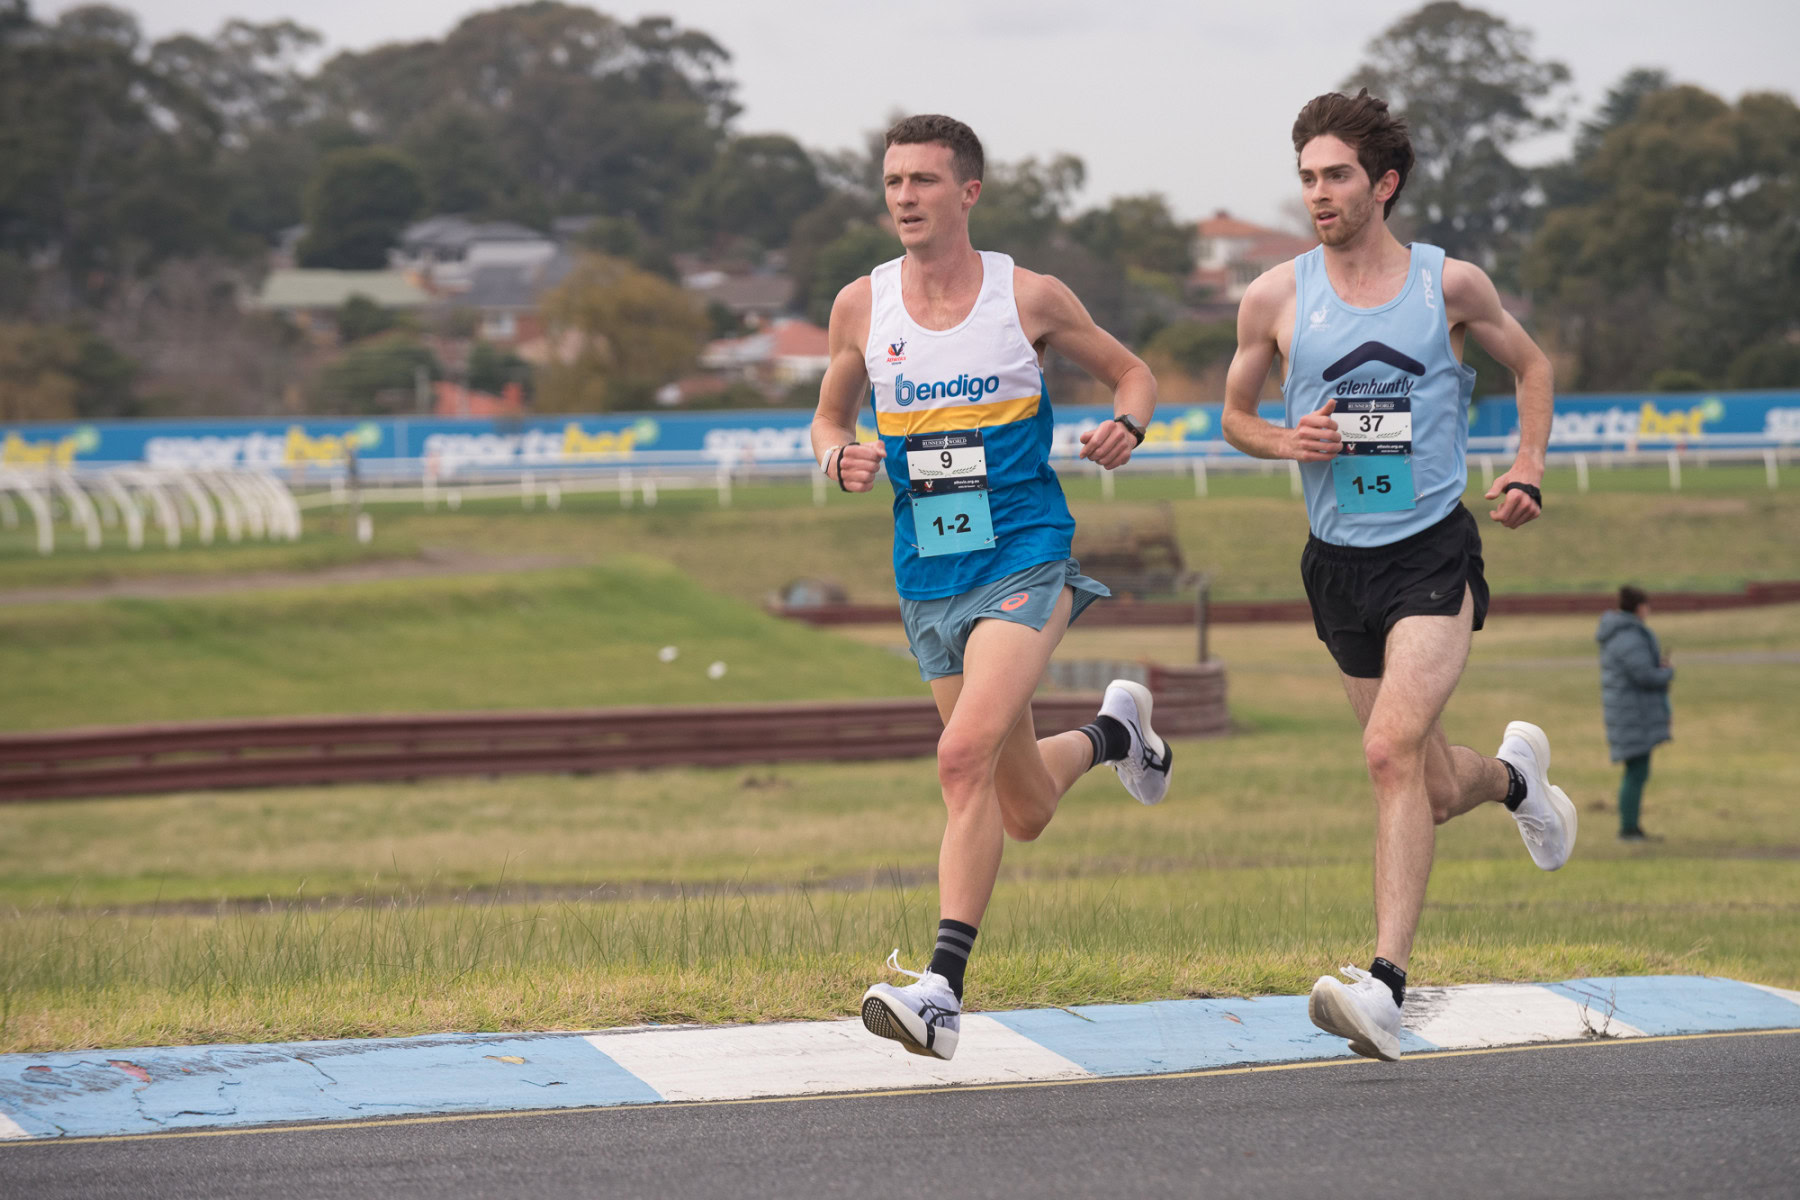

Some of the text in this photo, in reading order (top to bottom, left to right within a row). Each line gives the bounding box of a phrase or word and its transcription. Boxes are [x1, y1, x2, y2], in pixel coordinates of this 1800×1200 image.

[1421, 267, 1435, 309] 2XU
[895, 373, 999, 407] bendigo
[1336, 376, 1414, 396] Glenhuntly
[1359, 415, 1384, 433] 37
[940, 451, 953, 469] 9
[1352, 474, 1392, 495] 1-5
[932, 513, 972, 536] 1-2
